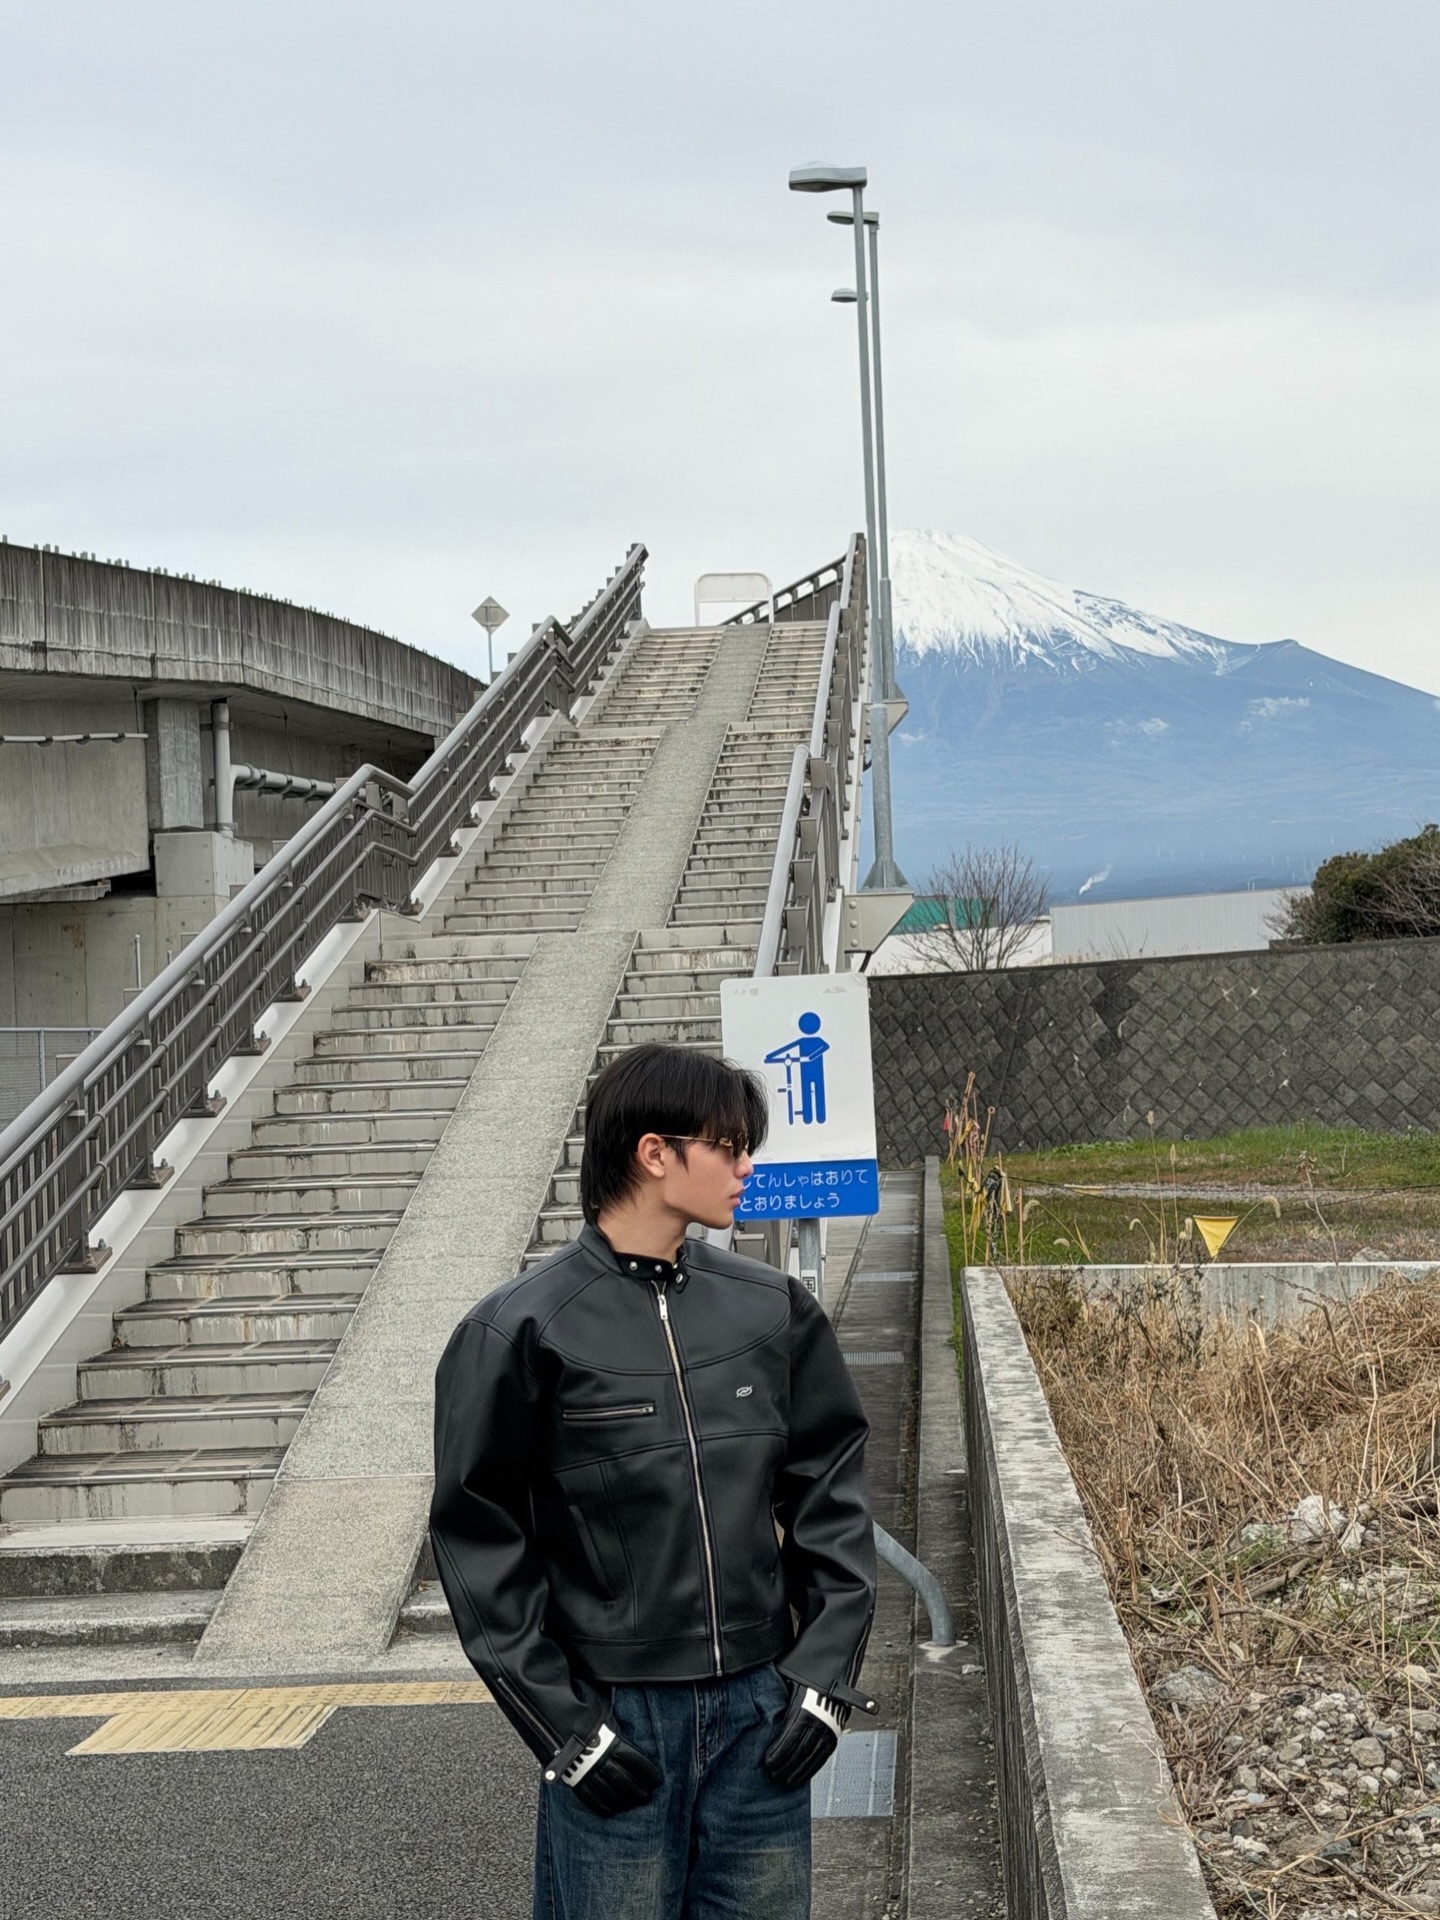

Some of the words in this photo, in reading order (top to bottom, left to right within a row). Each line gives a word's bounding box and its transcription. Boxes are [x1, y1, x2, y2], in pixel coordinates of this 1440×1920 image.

[740, 1192, 841, 1212] とおりましょう
